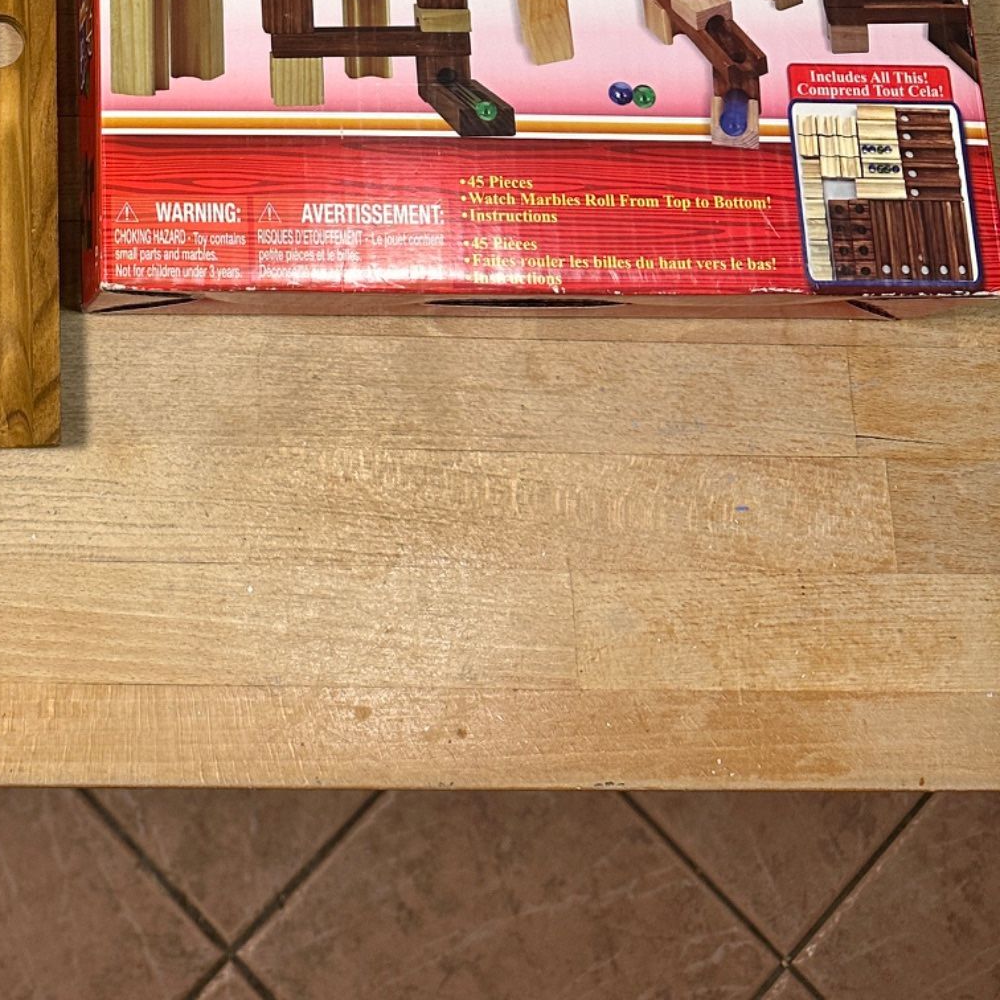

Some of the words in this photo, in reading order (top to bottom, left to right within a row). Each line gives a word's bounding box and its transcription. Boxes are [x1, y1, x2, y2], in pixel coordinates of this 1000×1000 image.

[809, 70, 867, 84] Includes
[870, 71, 891, 84] All
[893, 71, 929, 85] This!
[796, 83, 870, 99] Comprend
[873, 85, 904, 97] Tout
[907, 85, 944, 98] Cela!
[466, 175, 485, 189] 45
[489, 175, 534, 189] Pieces
[468, 191, 516, 206] Watch
[520, 192, 581, 207] Marbles
[585, 193, 616, 207] Roll
[619, 193, 660, 208] From
[663, 194, 691, 211] Top
[695, 196, 710, 209] to
[713, 195, 772, 210] Bottom!
[155, 201, 242, 223] WARNING:
[301, 202, 445, 226] AVERTISSEMENT:
[469, 208, 558, 223] Instructions
[114, 228, 151, 245] CHOKING
[153, 229, 186, 245] HAZARD
[192, 231, 208, 247] Toy
[209, 232, 247, 245] contains
[257, 229, 293, 246] RISQUES
[471, 236, 488, 250] 45
[493, 236, 538, 250] Pièces
[115, 247, 138, 261] small
[139, 248, 162, 262] parts
[163, 247, 180, 261] and
[181, 248, 219, 261] marbles.
[472, 253, 516, 268] Faites
[521, 255, 566, 268] rouler
[569, 255, 590, 269] les
[593, 255, 632, 269] billes
[635, 255, 655, 270] du
[658, 256, 693, 270] haut
[695, 258, 727, 271] vers
[730, 256, 744, 271] le
[746, 256, 777, 271] bas!
[115, 264, 131, 277] Not
[132, 263, 145, 277] for
[147, 263, 181, 278] children
[182, 264, 207, 278] under
[208, 264, 215, 278] 3
[216, 265, 243, 280] years.
